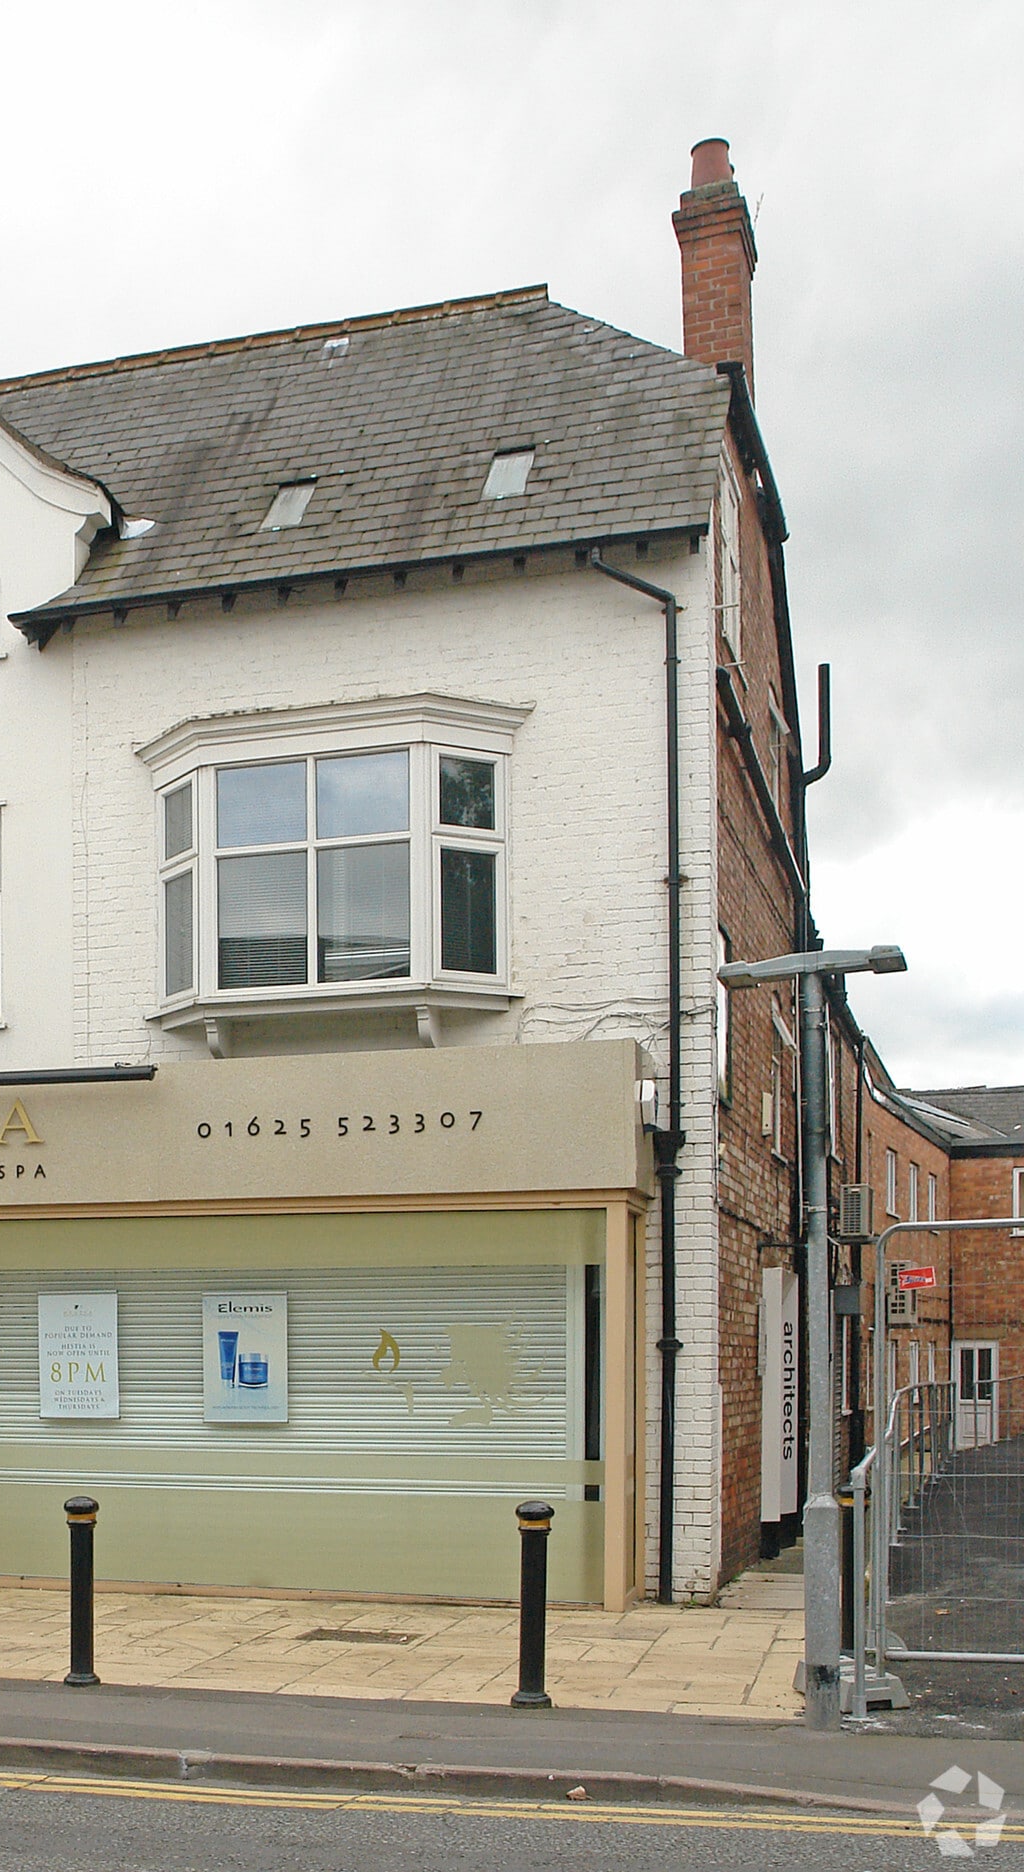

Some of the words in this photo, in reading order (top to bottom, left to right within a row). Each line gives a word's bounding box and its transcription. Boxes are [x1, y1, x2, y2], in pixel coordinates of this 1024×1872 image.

[197, 1116, 311, 1139] 01625
[337, 1111, 483, 1137] 523307
[80, 1331, 113, 1339] DEMAND
[782, 1321, 796, 1461] architects
